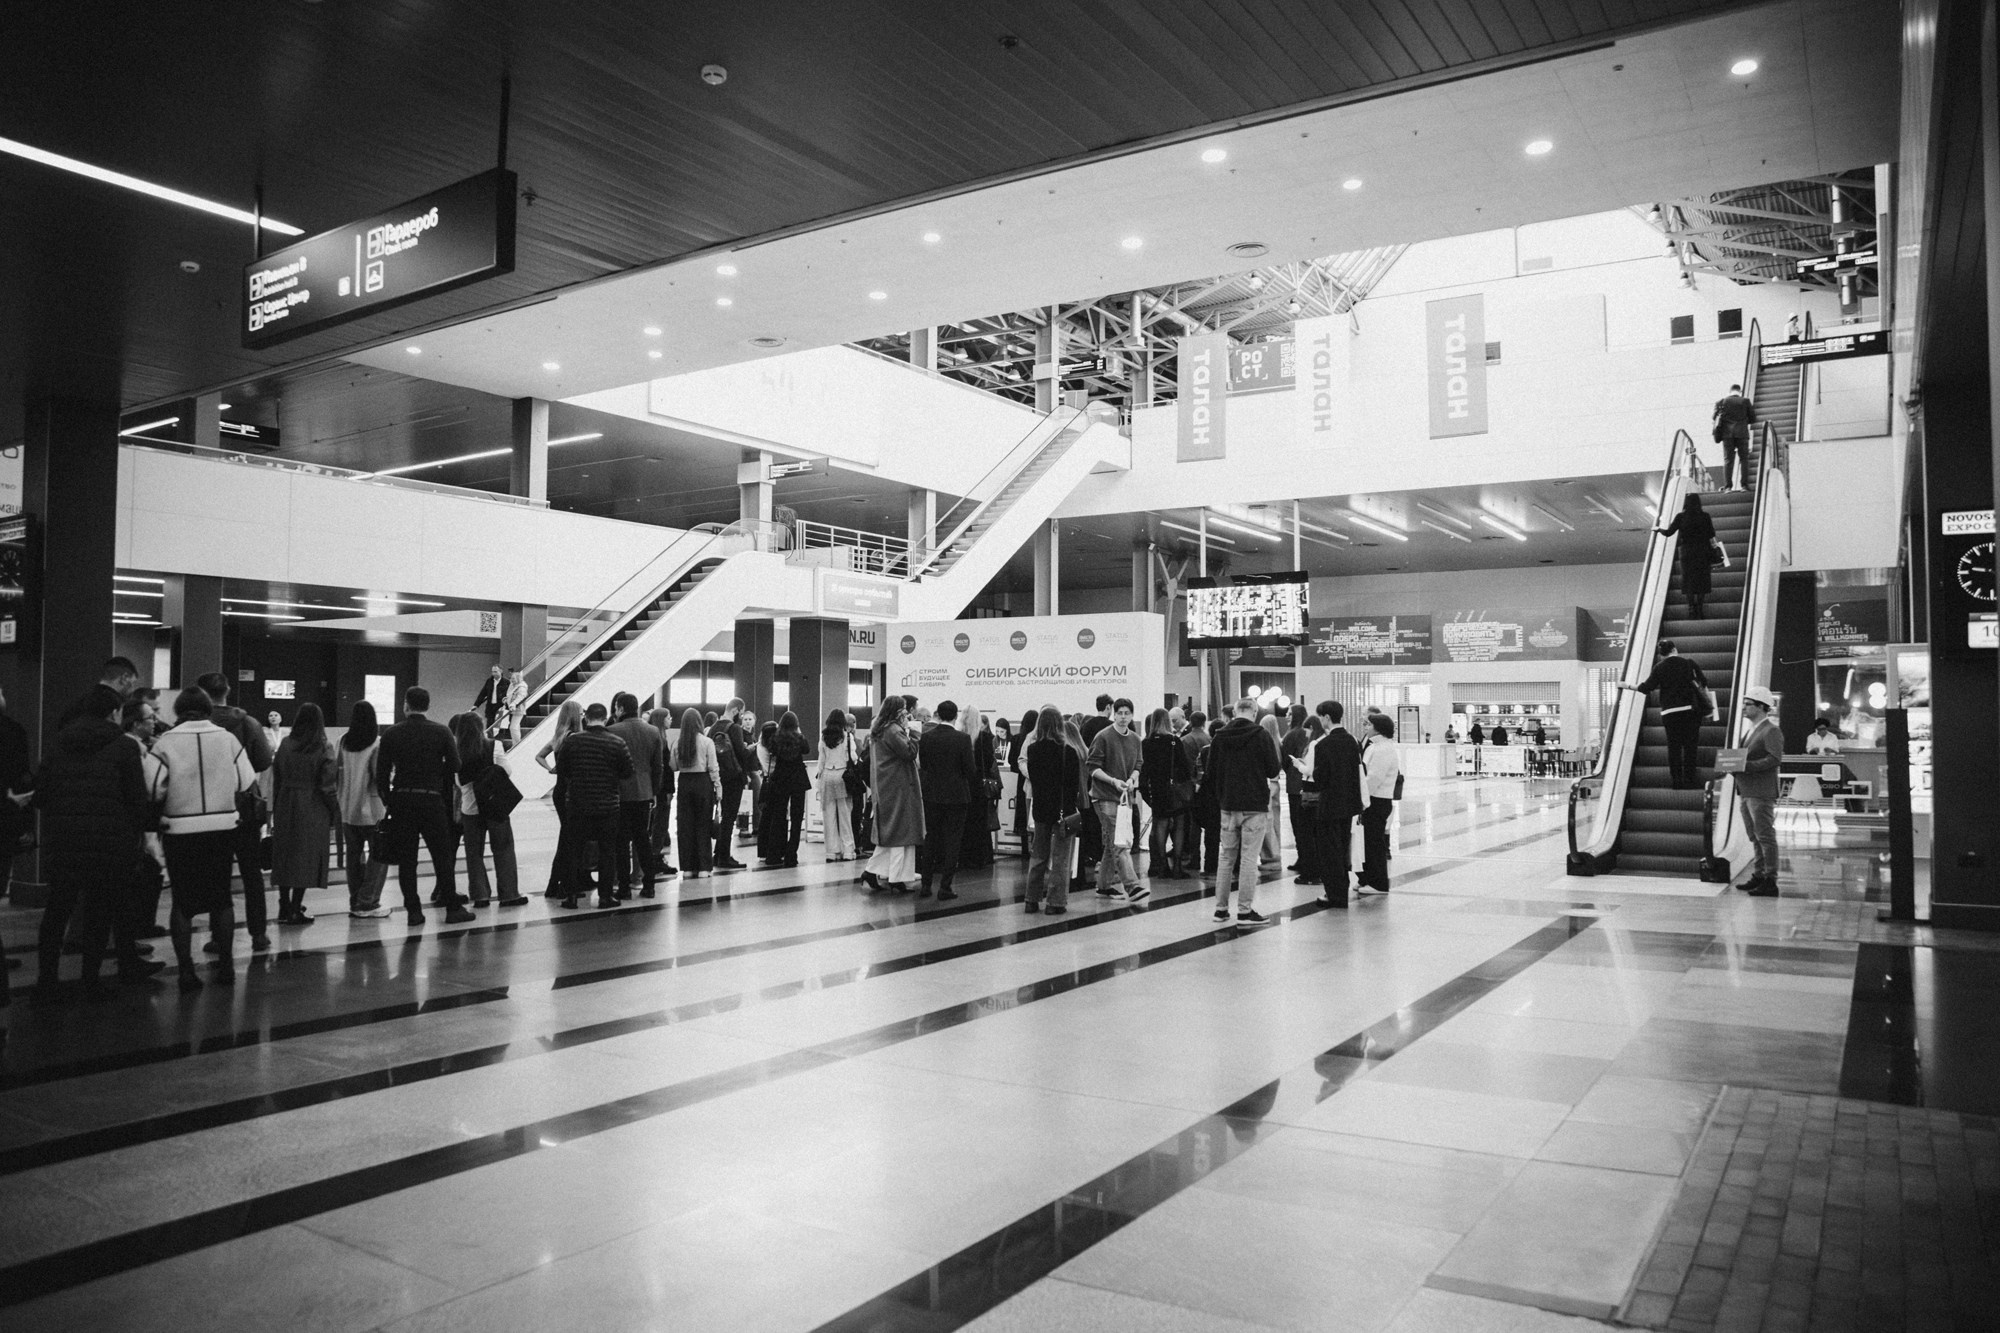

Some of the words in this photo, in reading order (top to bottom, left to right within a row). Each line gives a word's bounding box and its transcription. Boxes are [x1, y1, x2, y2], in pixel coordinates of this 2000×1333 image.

[385, 206, 438, 243] Гардероб
[849, 630, 875, 644] N.RU
[966, 664, 1061, 678] СИБИРСКИЙ
[1065, 665, 1127, 677] ФОРУМ
